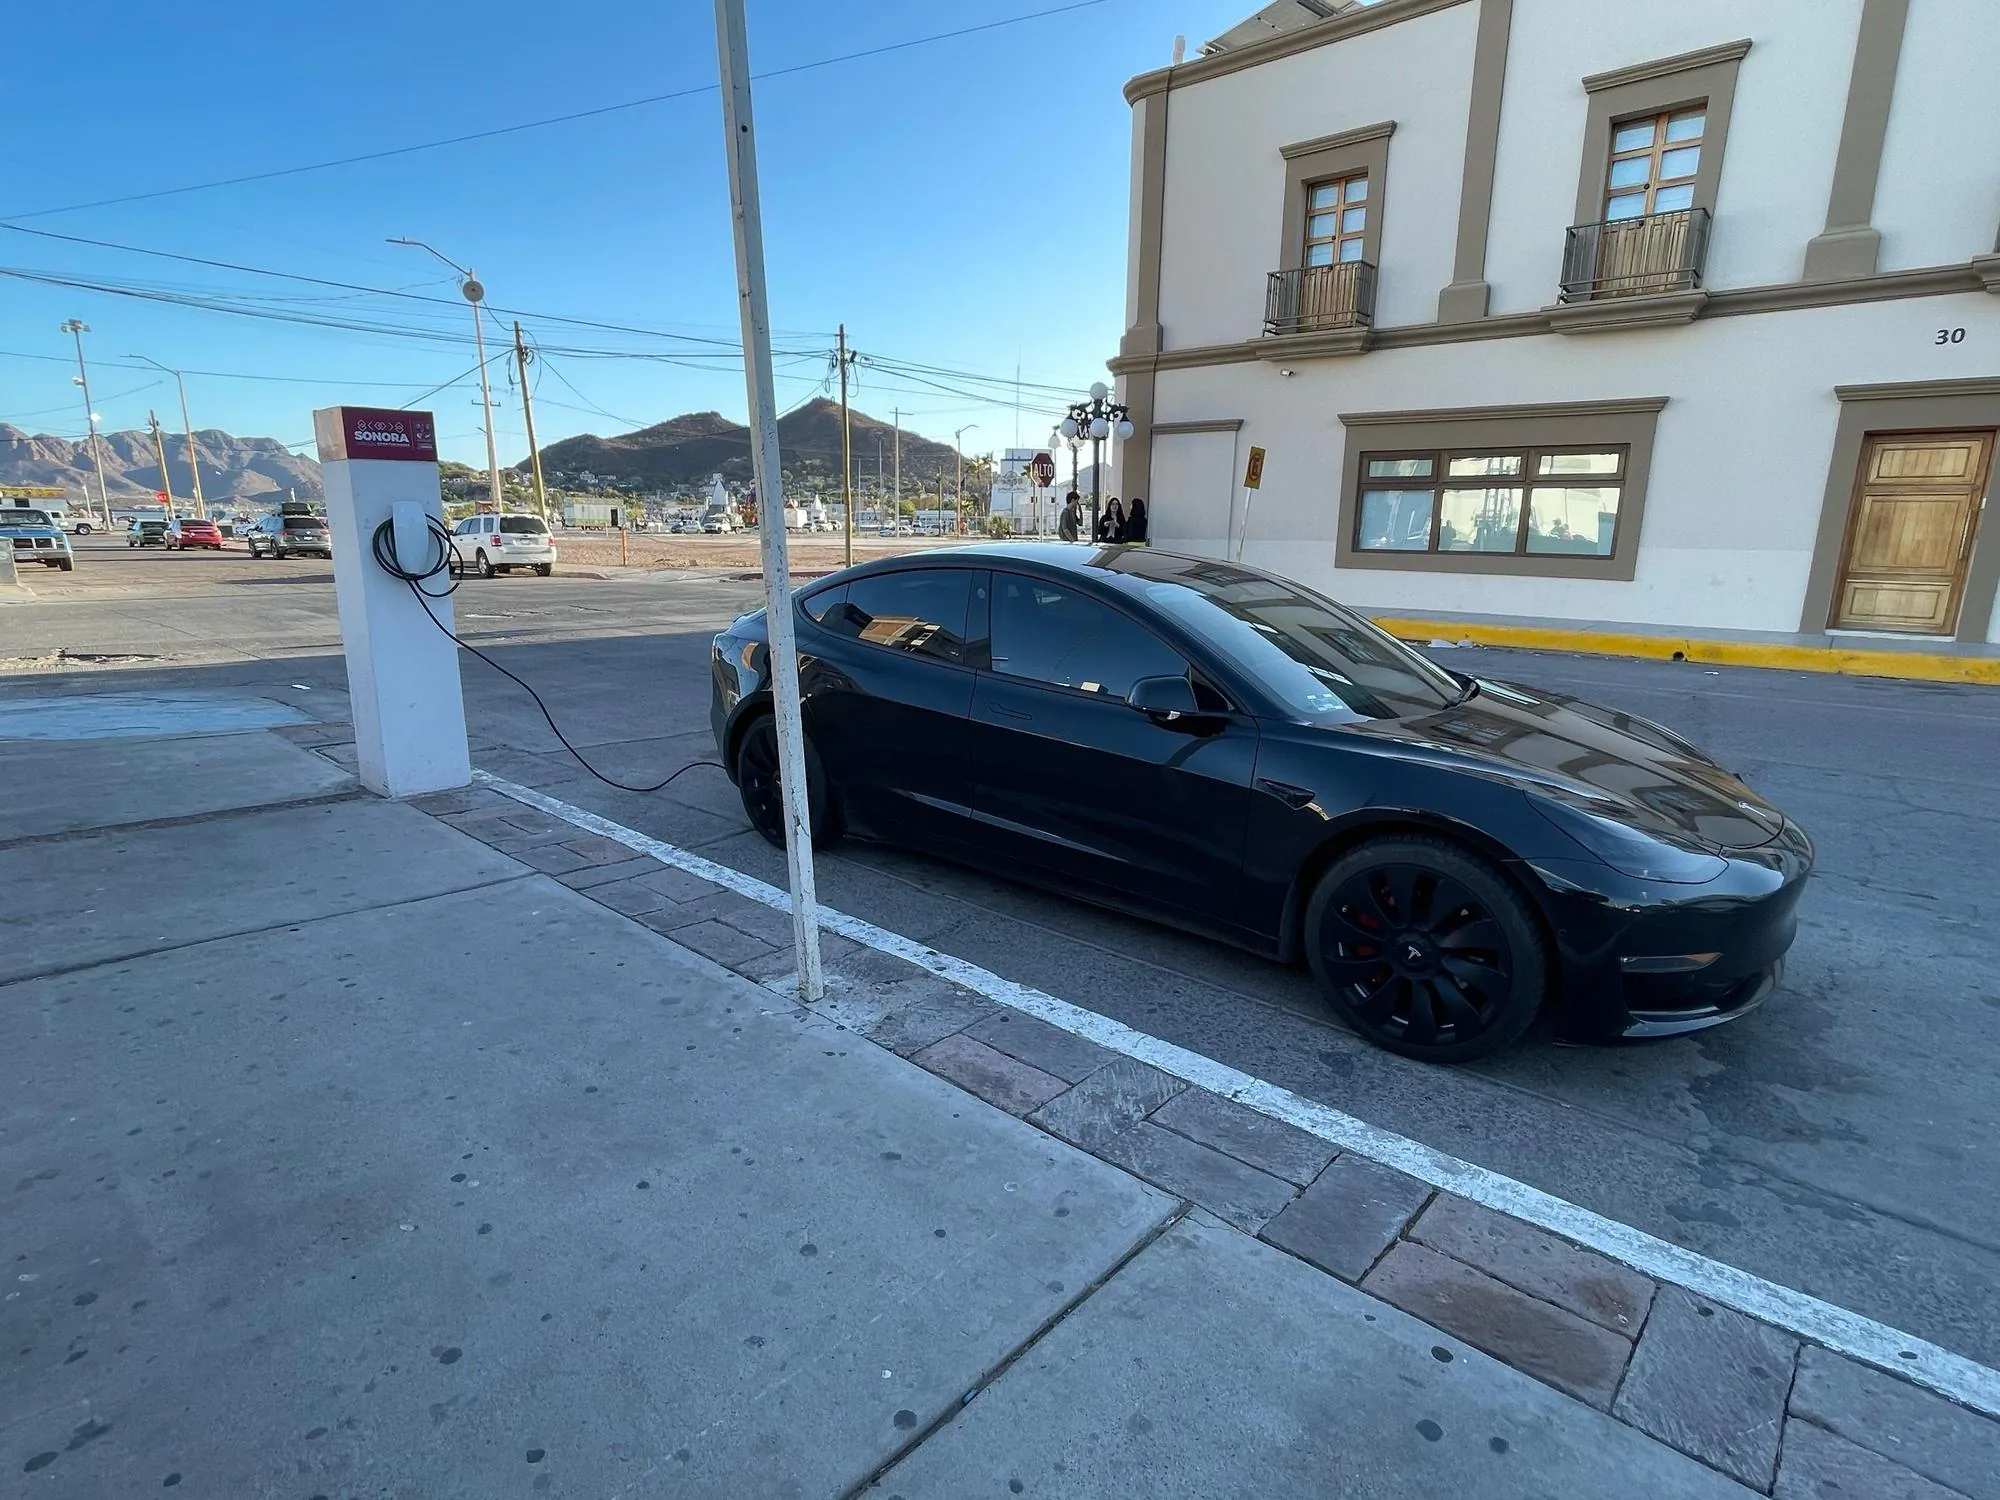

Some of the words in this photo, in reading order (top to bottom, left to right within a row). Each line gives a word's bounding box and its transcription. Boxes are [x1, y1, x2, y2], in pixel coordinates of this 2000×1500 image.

[1935, 328, 1966, 345] 30
[354, 431, 409, 443] SONORA
[1034, 463, 1053, 477] ALTO
